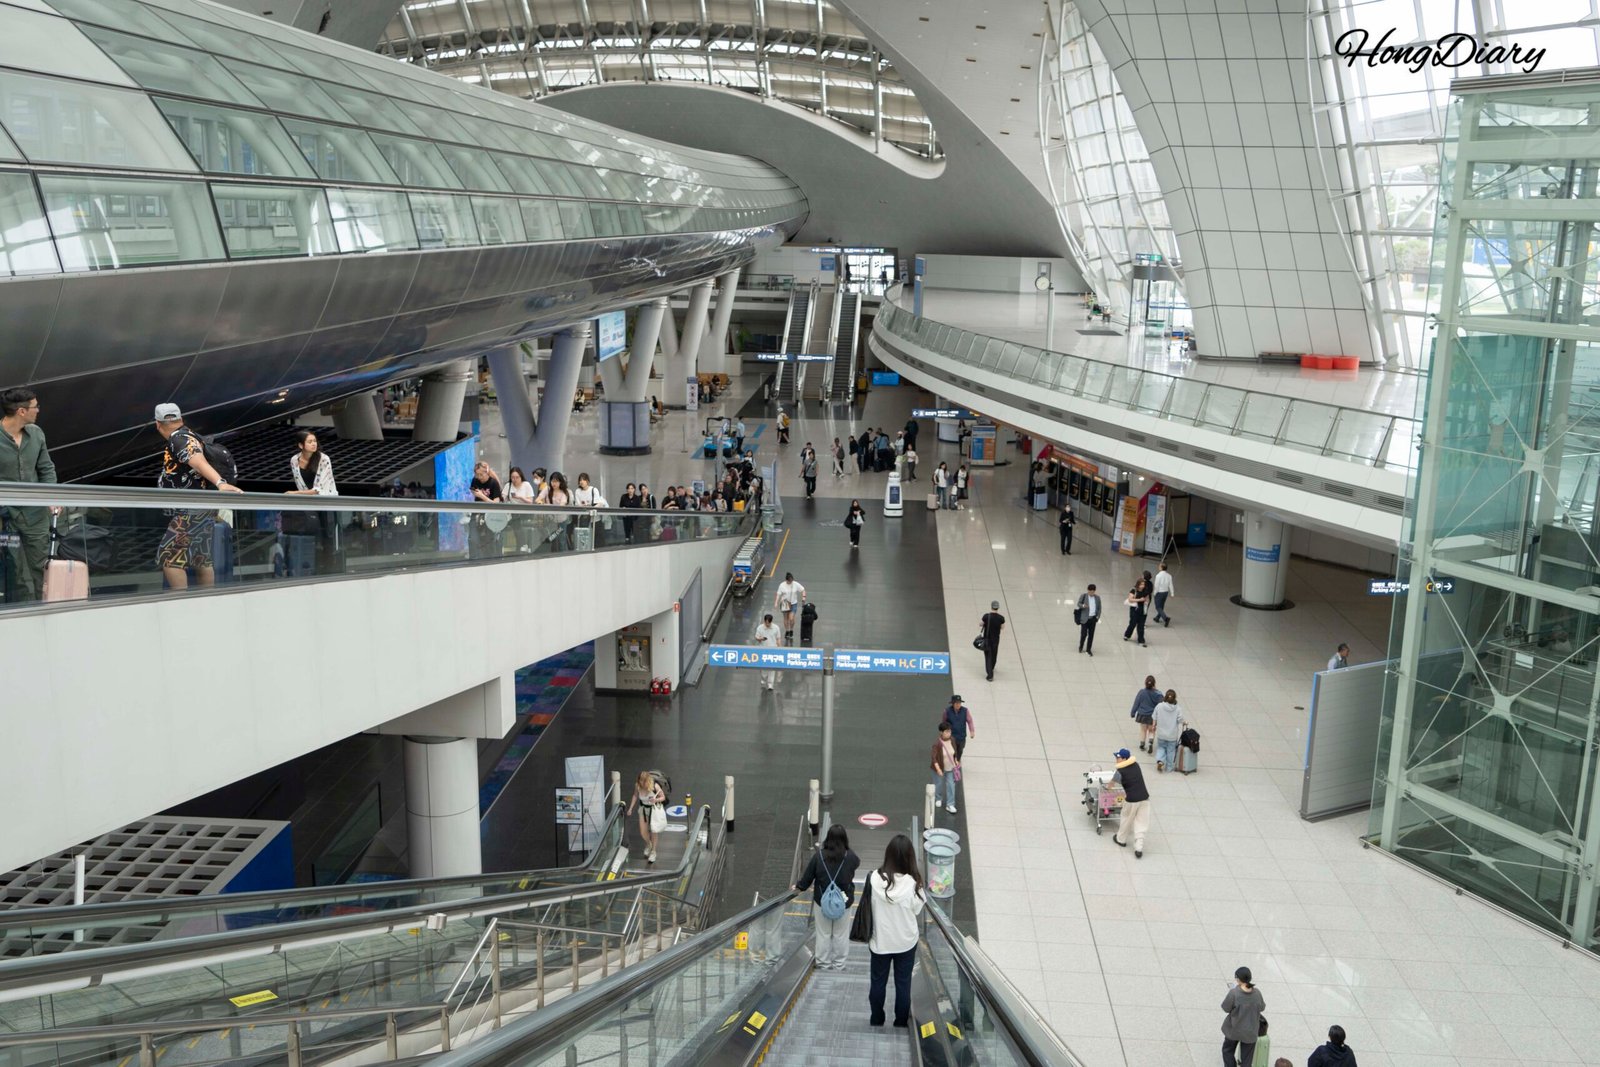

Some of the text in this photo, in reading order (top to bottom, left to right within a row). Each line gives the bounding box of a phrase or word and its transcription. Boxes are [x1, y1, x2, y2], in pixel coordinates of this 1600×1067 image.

[741, 653, 759, 663] A,D
[787, 659, 807, 667] Parking
[836, 661, 856, 669] Parking
[899, 659, 917, 669] H,C
